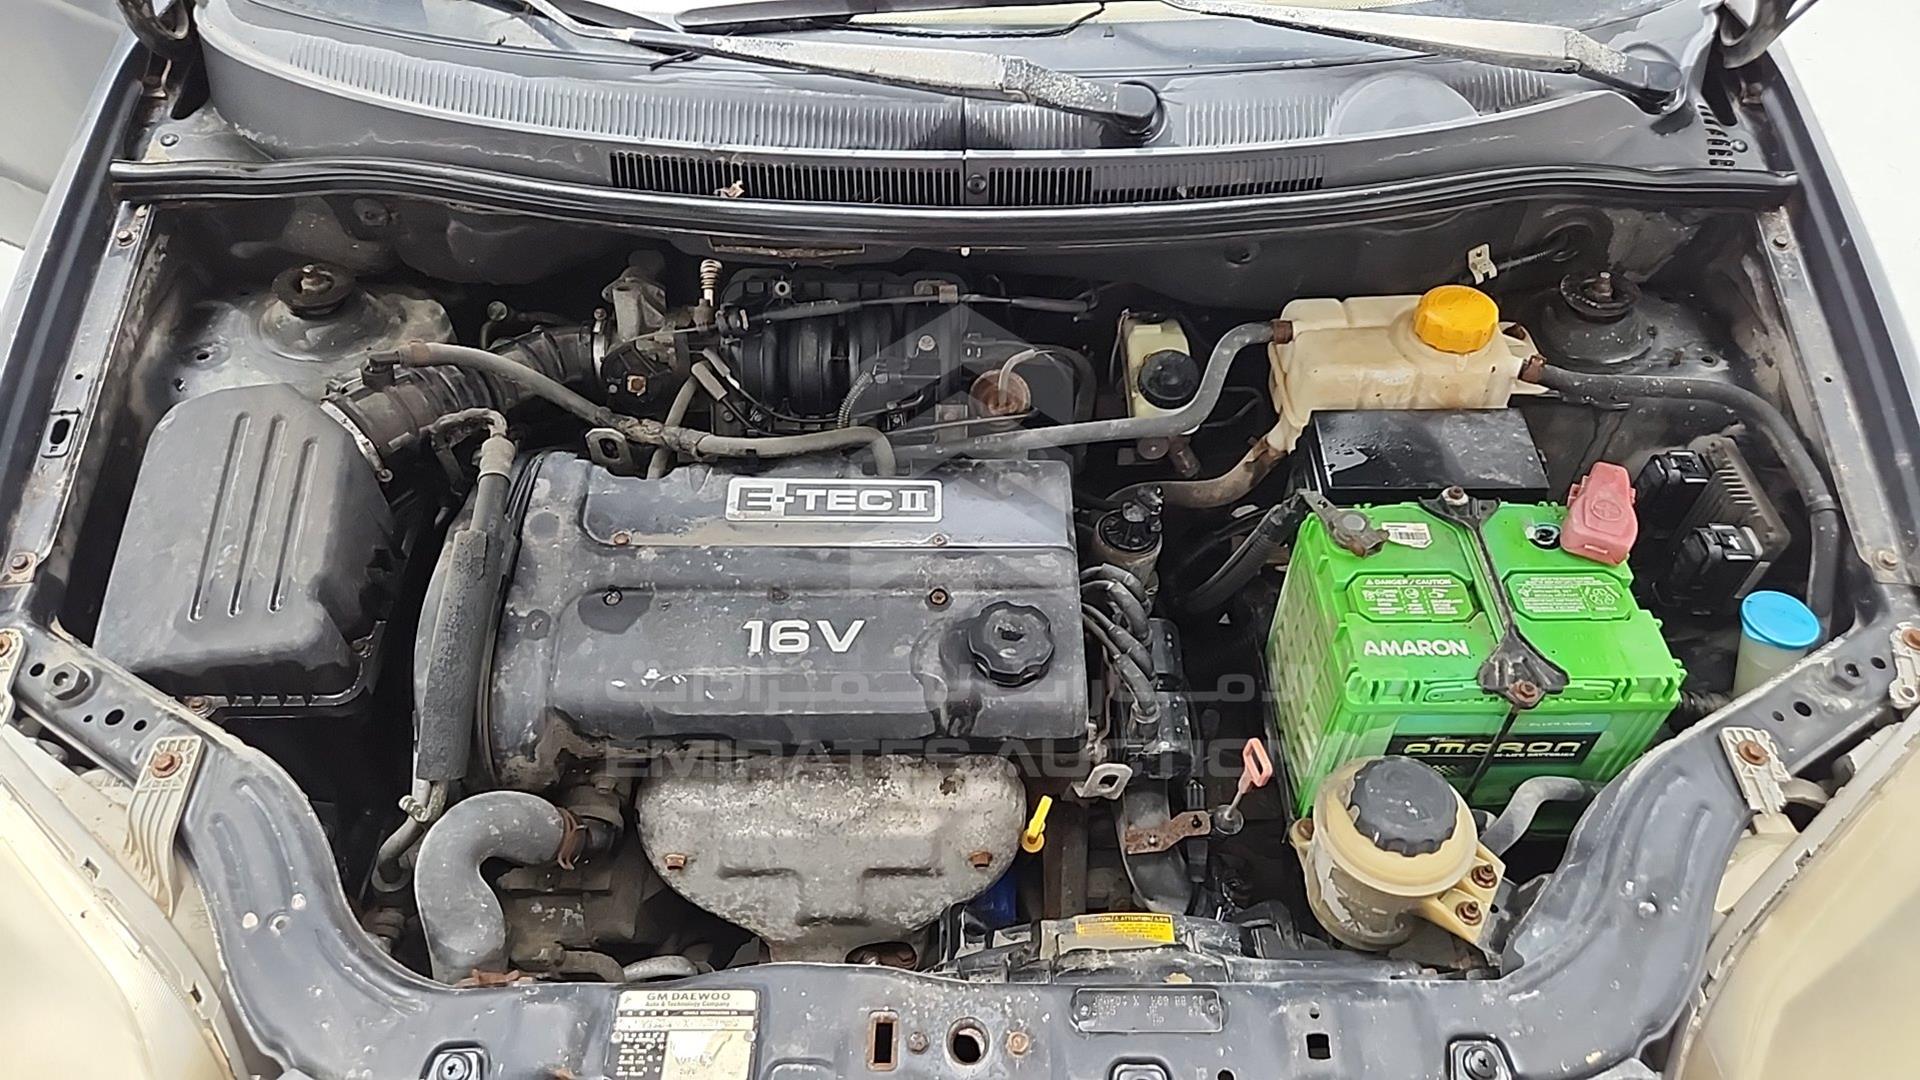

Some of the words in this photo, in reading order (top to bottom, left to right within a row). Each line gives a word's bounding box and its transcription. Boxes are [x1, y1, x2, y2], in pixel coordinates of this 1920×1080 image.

[742, 619, 866, 653] 16V
[1363, 639, 1470, 657] AMARON
[647, 992, 668, 1001] GM
[671, 992, 731, 1001] DAEWOO
